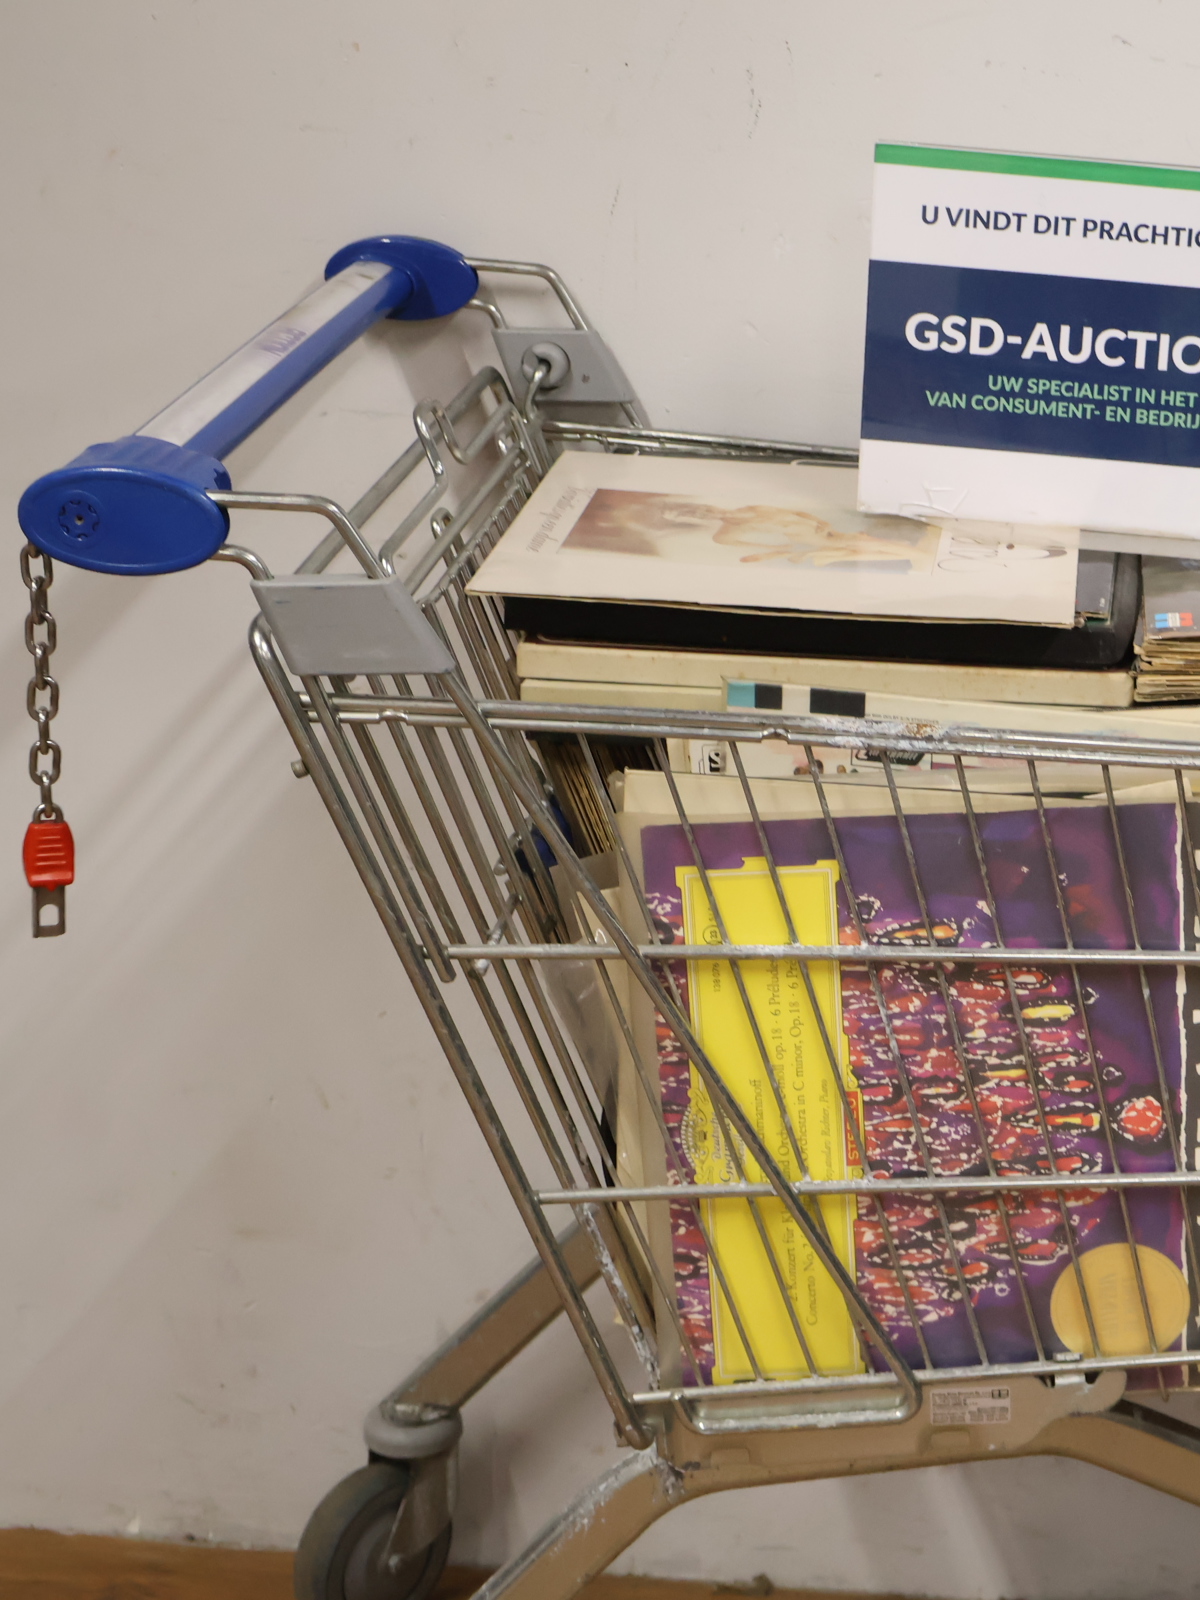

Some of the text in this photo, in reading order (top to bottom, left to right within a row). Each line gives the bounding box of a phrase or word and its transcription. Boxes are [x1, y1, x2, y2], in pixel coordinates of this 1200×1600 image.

[921, 205, 938, 225] U
[946, 207, 1027, 232] VINDT
[1033, 214, 1076, 236] DIT
[926, 390, 966, 409] VAN
[971, 395, 1100, 420] CONSUMENT-
[1105, 406, 1130, 423] EN
[988, 375, 1023, 392] UW
[1027, 378, 1132, 402] SPECIALIST
[1135, 387, 1155, 404] IN
[1160, 390, 1198, 408] HET
[749, 1079, 764, 1145] chmaninoff
